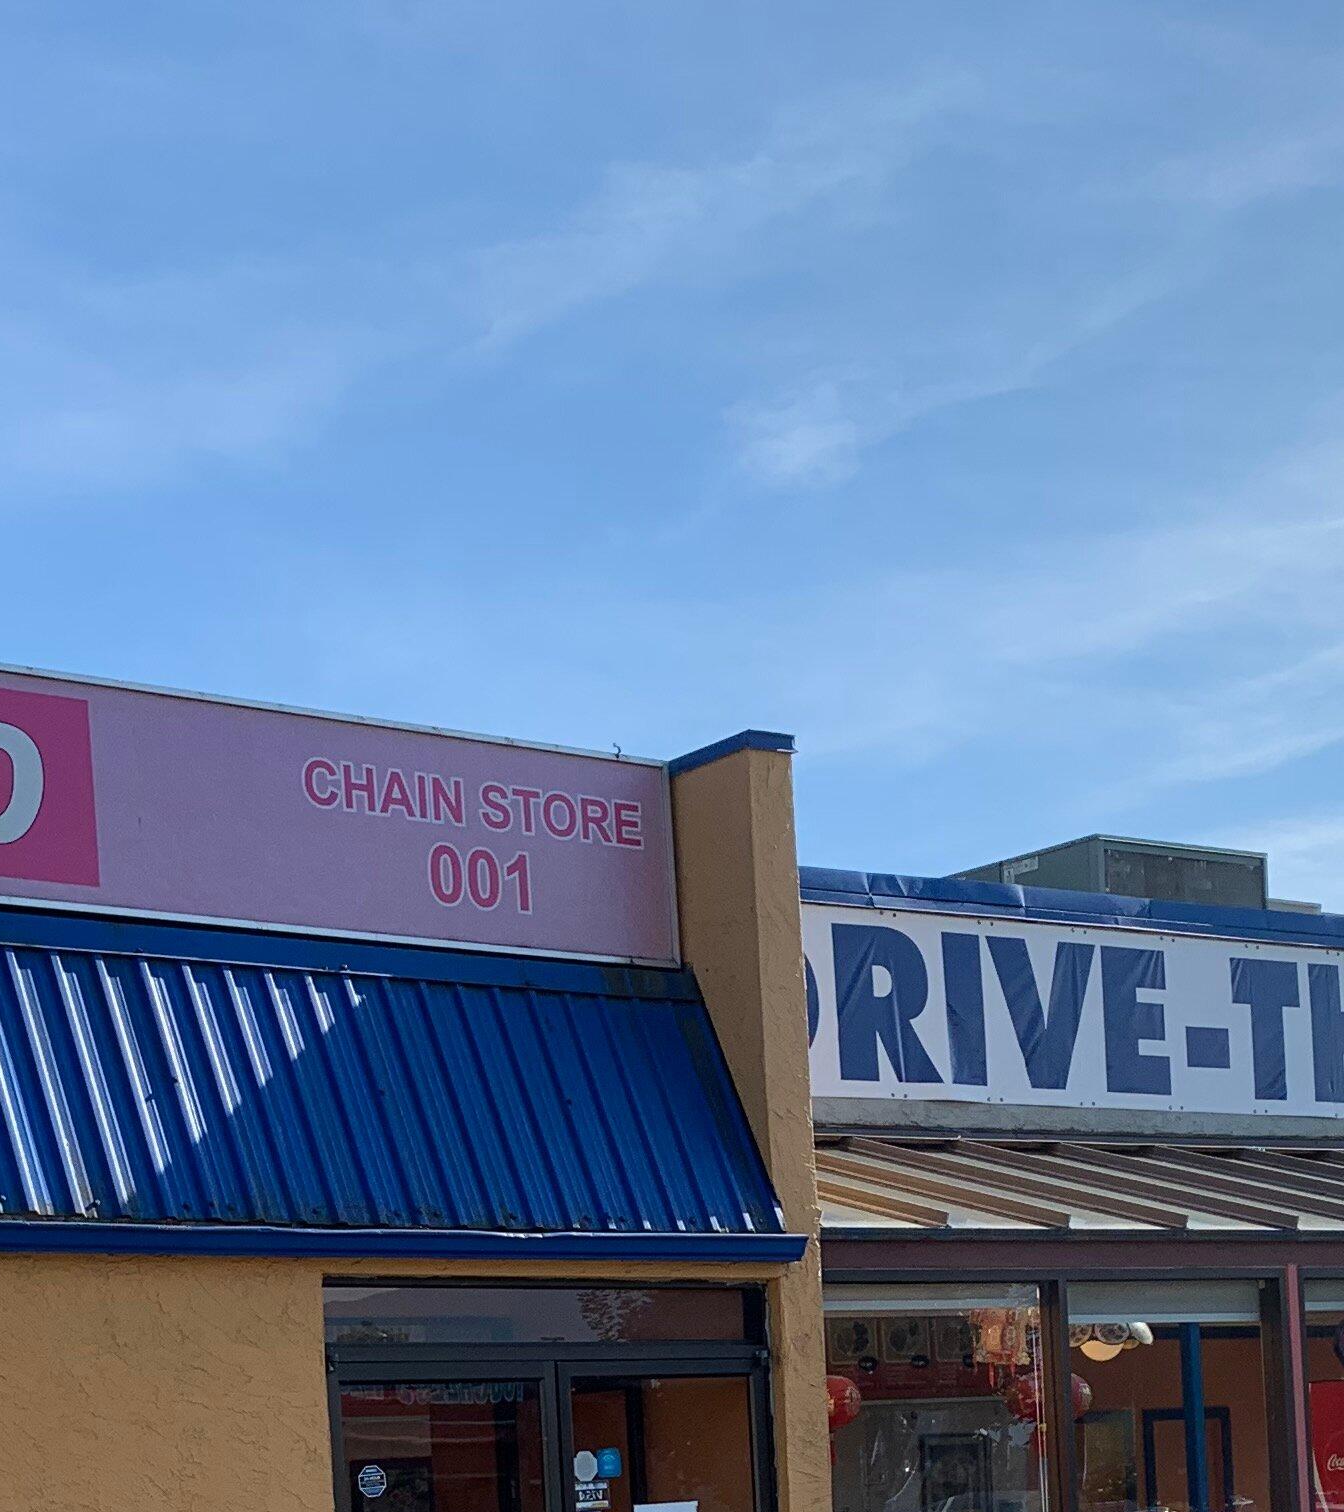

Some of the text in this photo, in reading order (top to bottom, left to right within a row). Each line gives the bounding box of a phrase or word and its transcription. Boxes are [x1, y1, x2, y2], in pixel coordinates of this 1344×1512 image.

[302, 756, 645, 850] CHAIN STORE
[427, 841, 533, 915] 001
